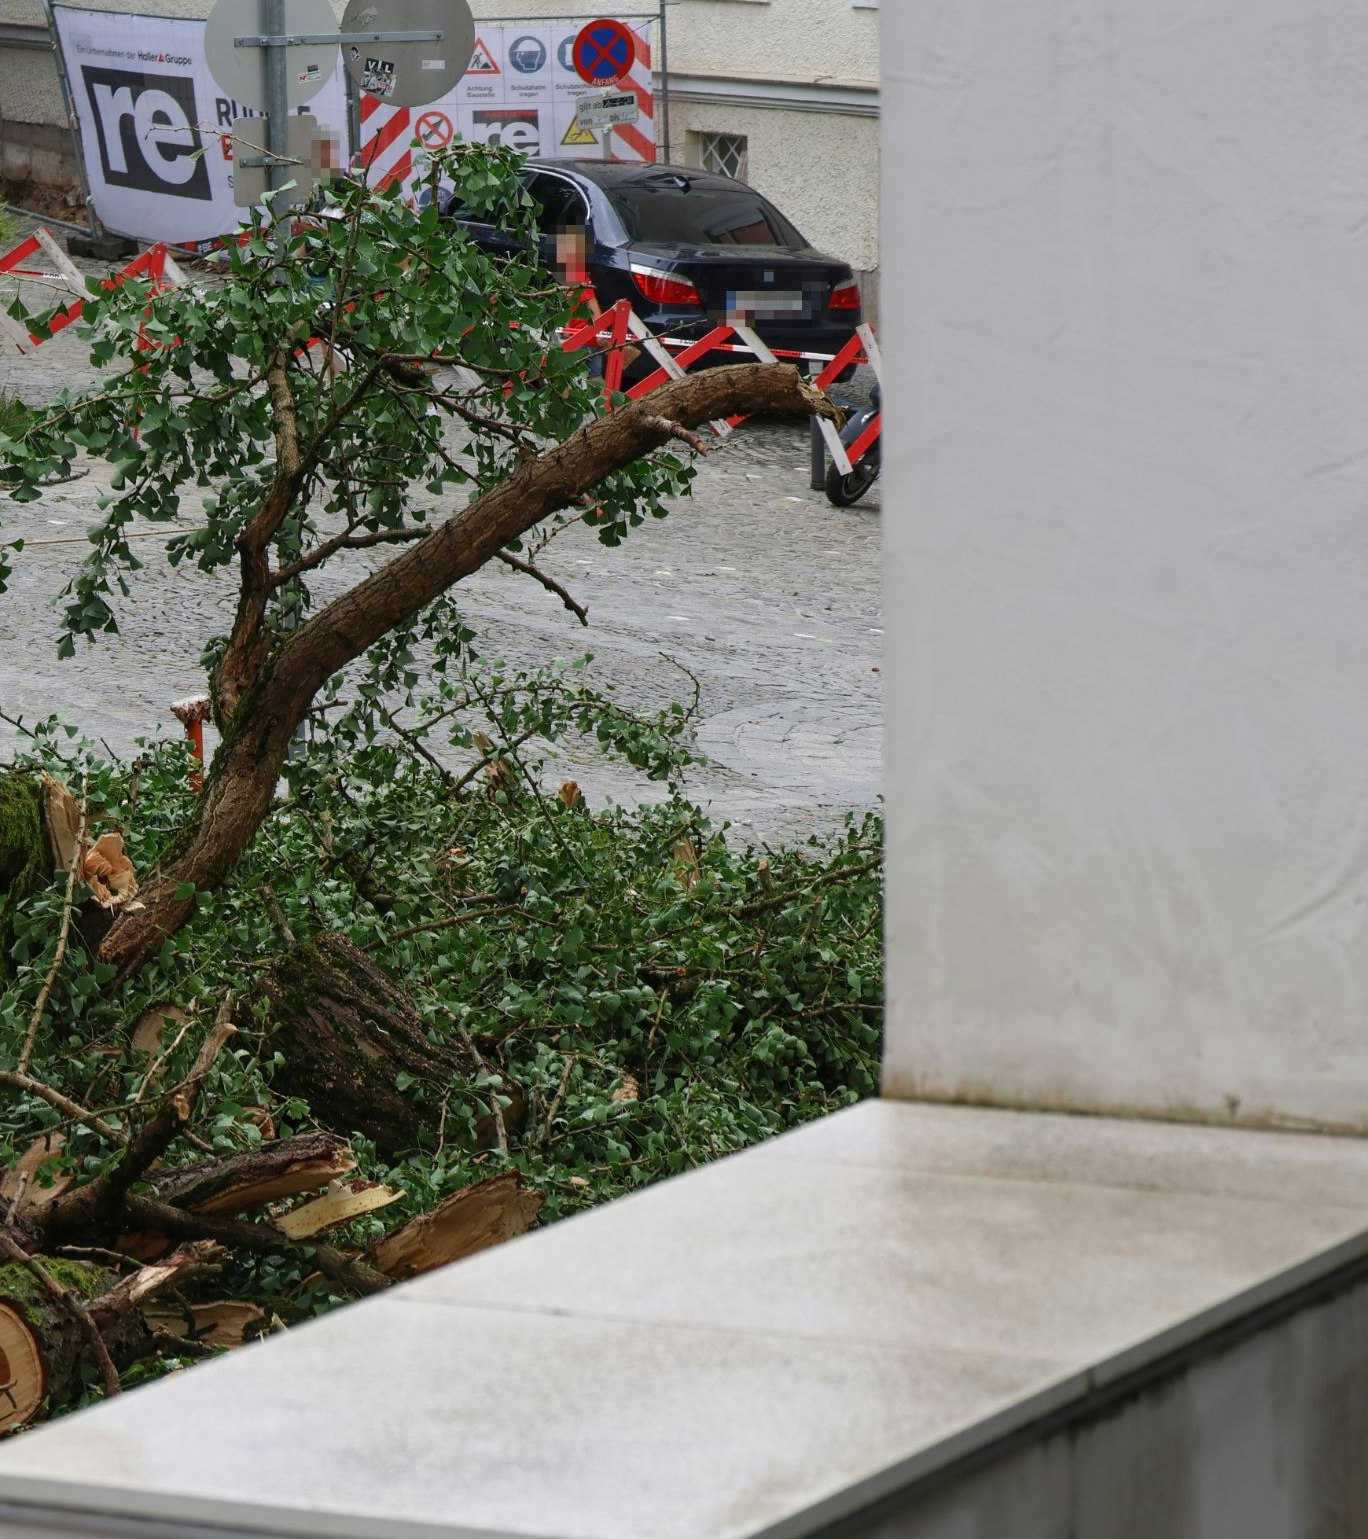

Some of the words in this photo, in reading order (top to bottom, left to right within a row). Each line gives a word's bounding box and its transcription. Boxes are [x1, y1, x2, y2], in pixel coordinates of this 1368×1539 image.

[126, 51, 136, 60] der
[591, 75, 619, 86] ANFANG
[579, 103, 591, 114] gilt
[592, 101, 602, 110] ab
[580, 118, 593, 127] von
[610, 114, 620, 123] bis
[91, 83, 199, 186] re
[473, 121, 540, 156] re
